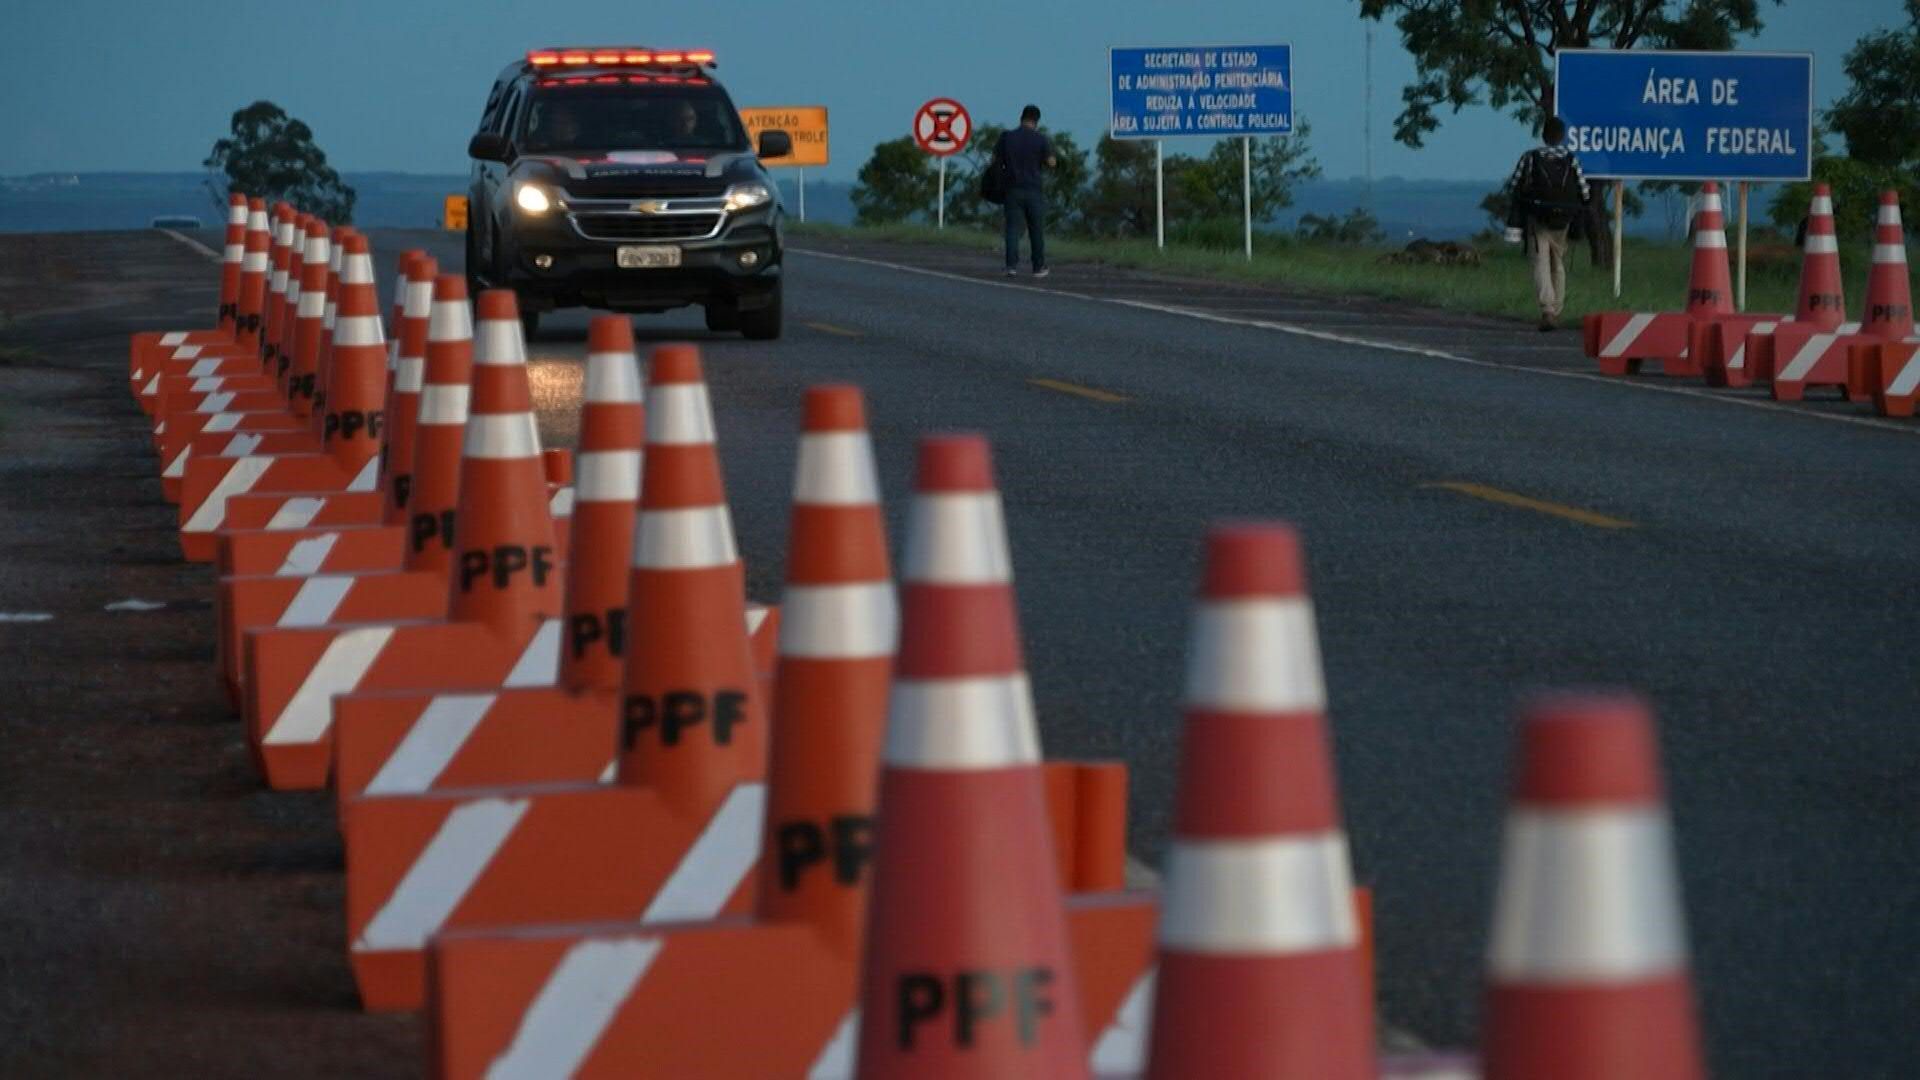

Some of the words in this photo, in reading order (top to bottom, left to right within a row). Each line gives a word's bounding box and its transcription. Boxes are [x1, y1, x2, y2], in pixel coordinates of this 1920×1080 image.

[1144, 52, 1200, 68] SECRETARIA
[1204, 53, 1218, 68] DE
[1221, 52, 1258, 67] ESTADO
[1118, 74, 1132, 90] DE
[1136, 71, 1211, 91] ADMINISTRAÇÃO
[1214, 68, 1284, 88] PENITENCIÁRIA
[1642, 67, 1700, 105] ÁREA
[1711, 78, 1739, 106] DE
[1146, 95, 1183, 110] REDUZA
[1188, 95, 1196, 110] A
[1200, 94, 1257, 109] VELOCIDADE
[1113, 112, 1138, 131] ÁREA
[1143, 115, 1181, 130] SUJEITA
[1186, 115, 1193, 129] A
[1197, 114, 1244, 129] CONTROLE
[1248, 113, 1290, 129] POLICIAL
[1567, 126, 1685, 160] SEGURANÇA
[1706, 127, 1797, 155] FEDERAL
[460, 545, 553, 592] PPF
[623, 689, 750, 753] PPF
[897, 965, 1056, 1051] PPF
